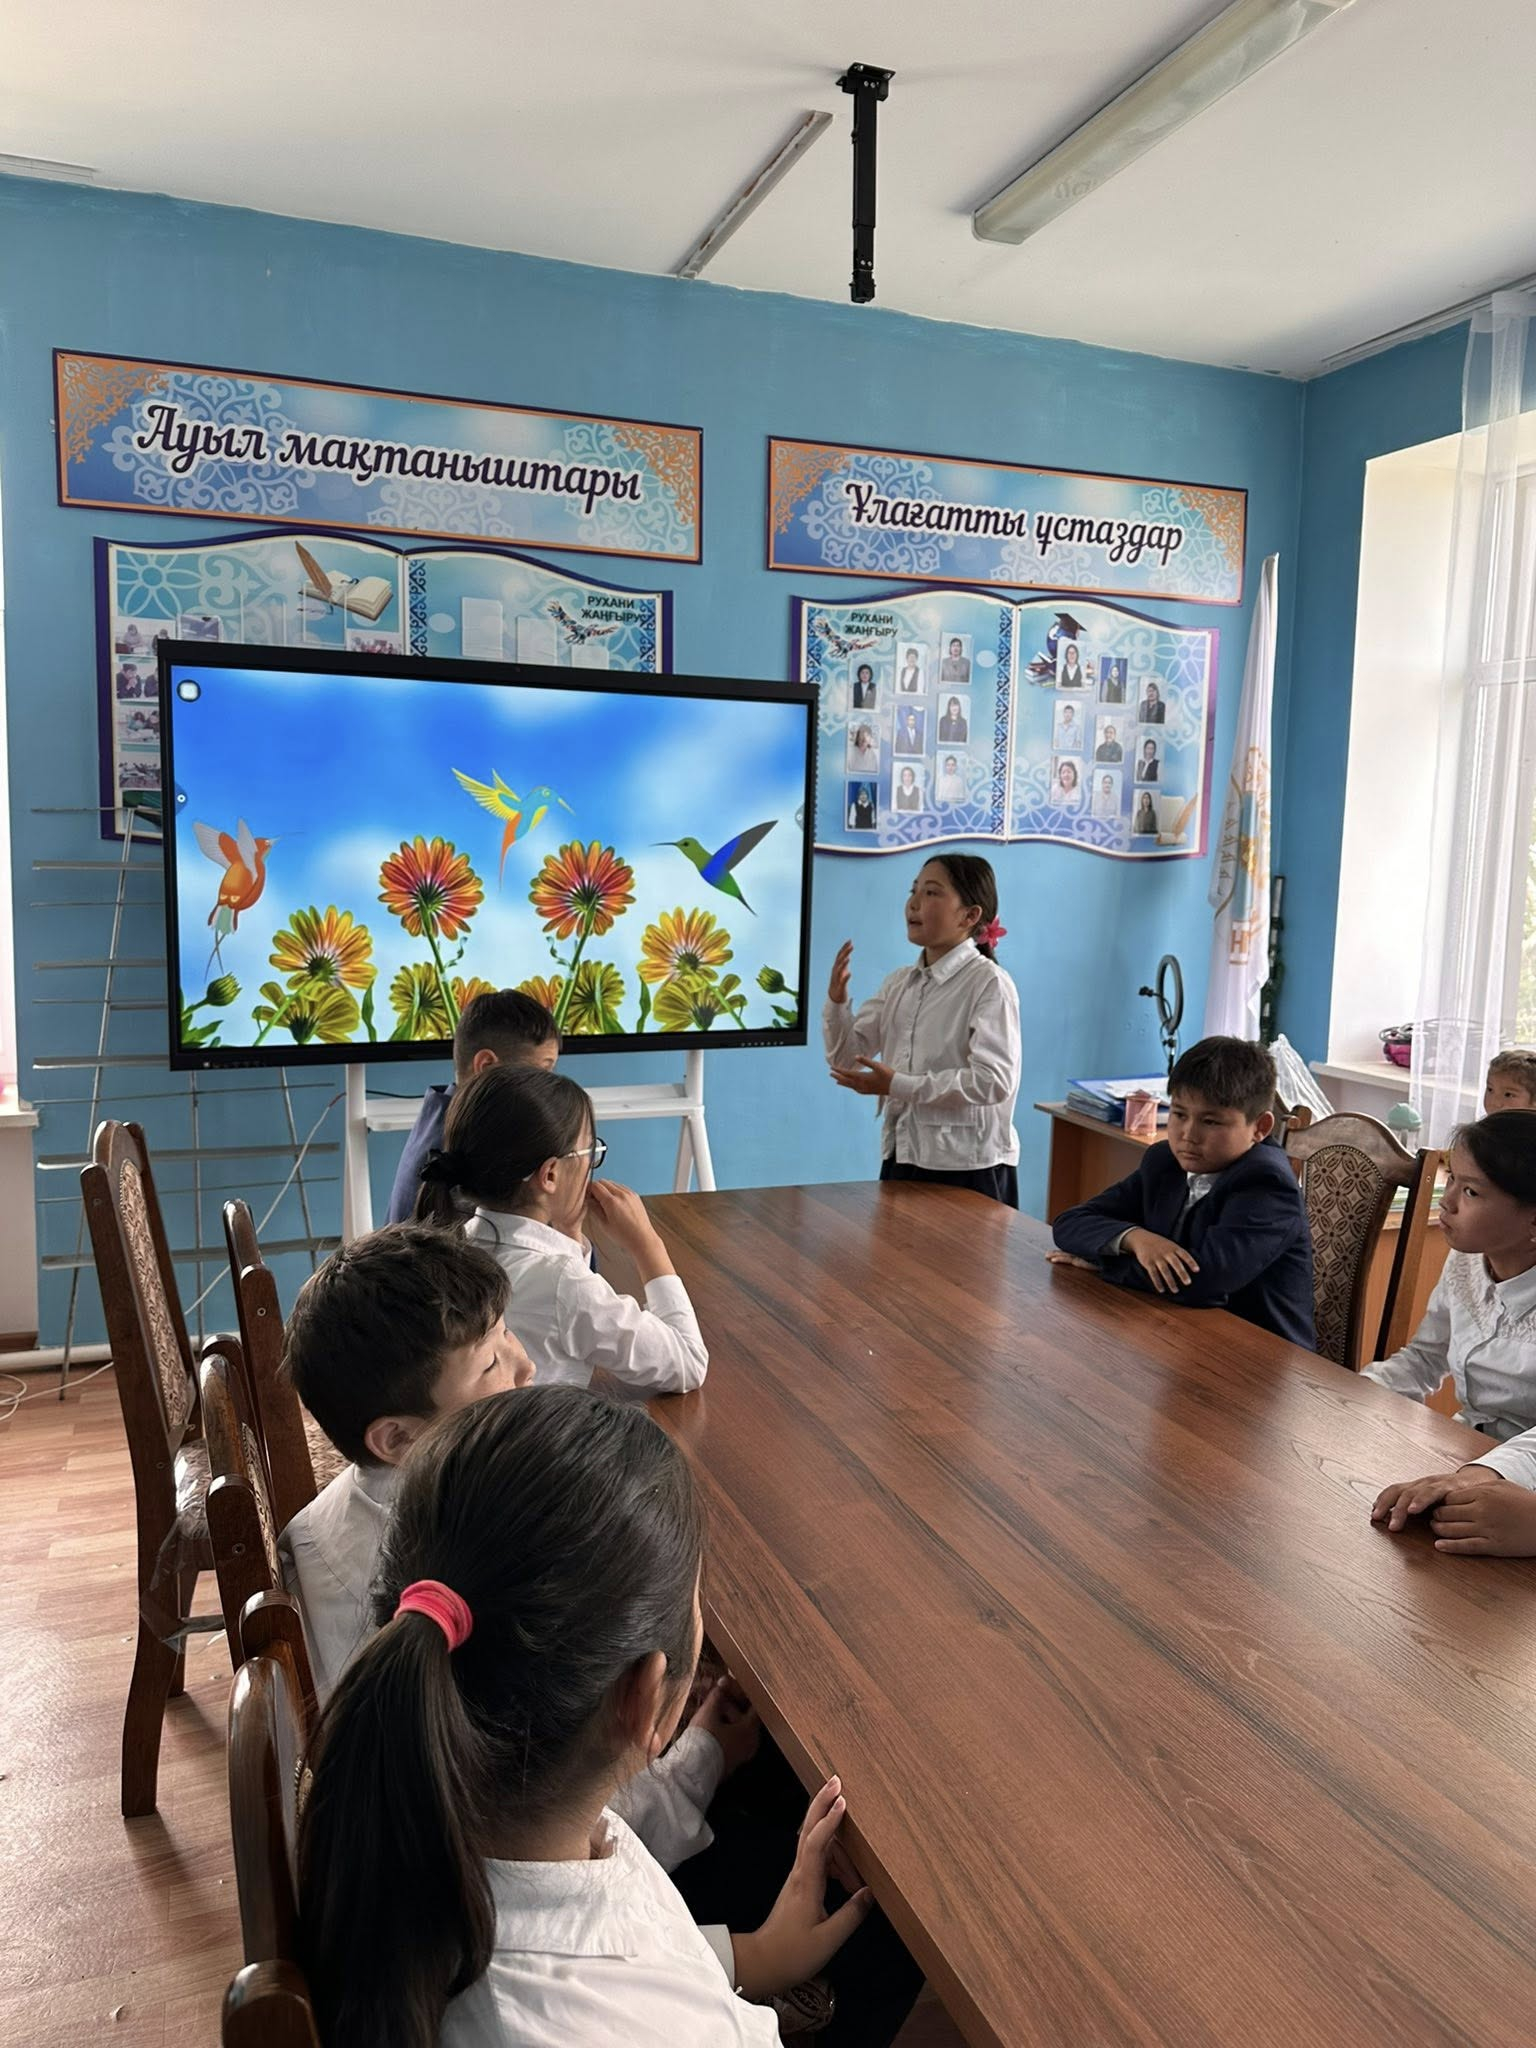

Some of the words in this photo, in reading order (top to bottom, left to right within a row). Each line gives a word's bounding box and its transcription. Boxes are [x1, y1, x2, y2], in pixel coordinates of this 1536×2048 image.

[137, 404, 267, 474] Ауыл
[279, 434, 641, 514] мақтаныштары
[845, 483, 1026, 537] Ұлағатты
[1036, 515, 1183, 566] ұстаздар
[587, 596, 635, 609] РУХАНИ
[851, 612, 894, 625] РУХАНИ
